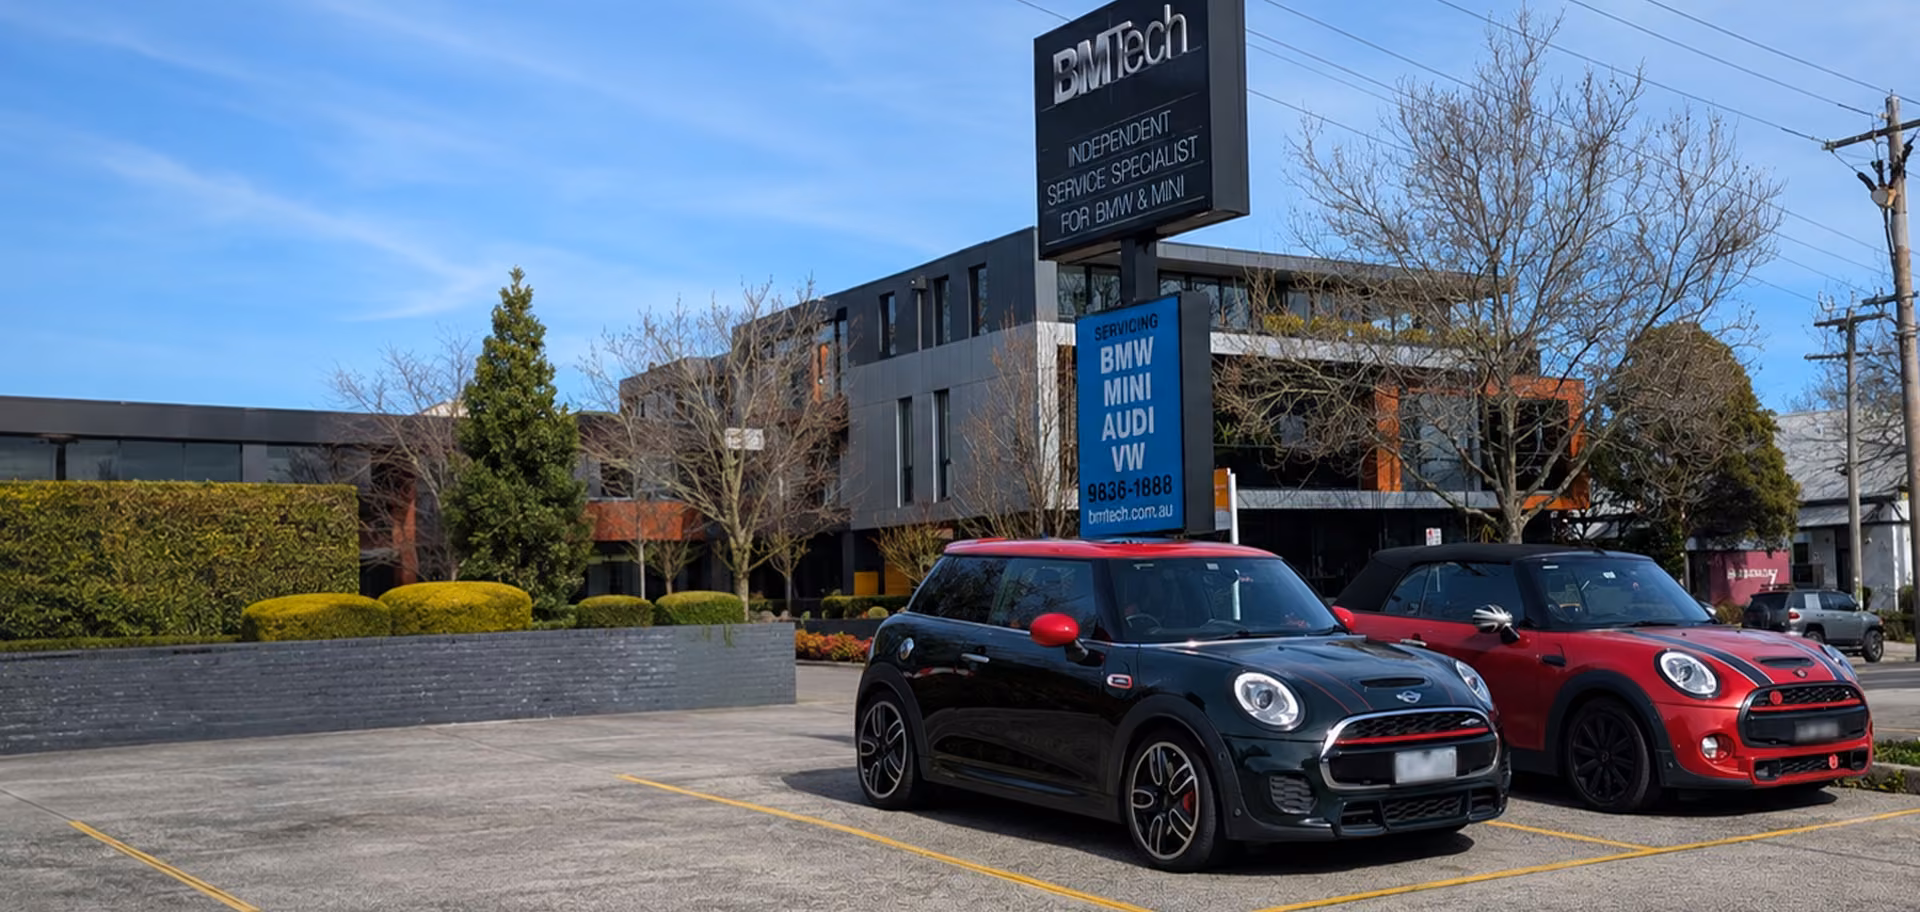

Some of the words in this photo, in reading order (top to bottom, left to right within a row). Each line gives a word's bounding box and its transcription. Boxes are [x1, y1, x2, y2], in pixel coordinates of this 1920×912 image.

[1053, 4, 1188, 105] BMTech
[1068, 110, 1171, 168] INDEPENDENT
[1047, 167, 1106, 206] SERVICE
[1111, 135, 1198, 184] SPECIALIST
[1061, 207, 1089, 234] FOR
[1096, 190, 1134, 224] BMW
[1137, 189, 1148, 210] &
[1151, 175, 1184, 205] MINI
[1095, 313, 1159, 341] SERVICING
[1101, 336, 1154, 374] BMW
[1104, 372, 1151, 407] MINI
[1102, 406, 1154, 441] AUDI
[1111, 442, 1146, 473] VW
[1088, 474, 1173, 503] 9836-1888
[1088, 503, 1173, 525] bmtech.com.au
